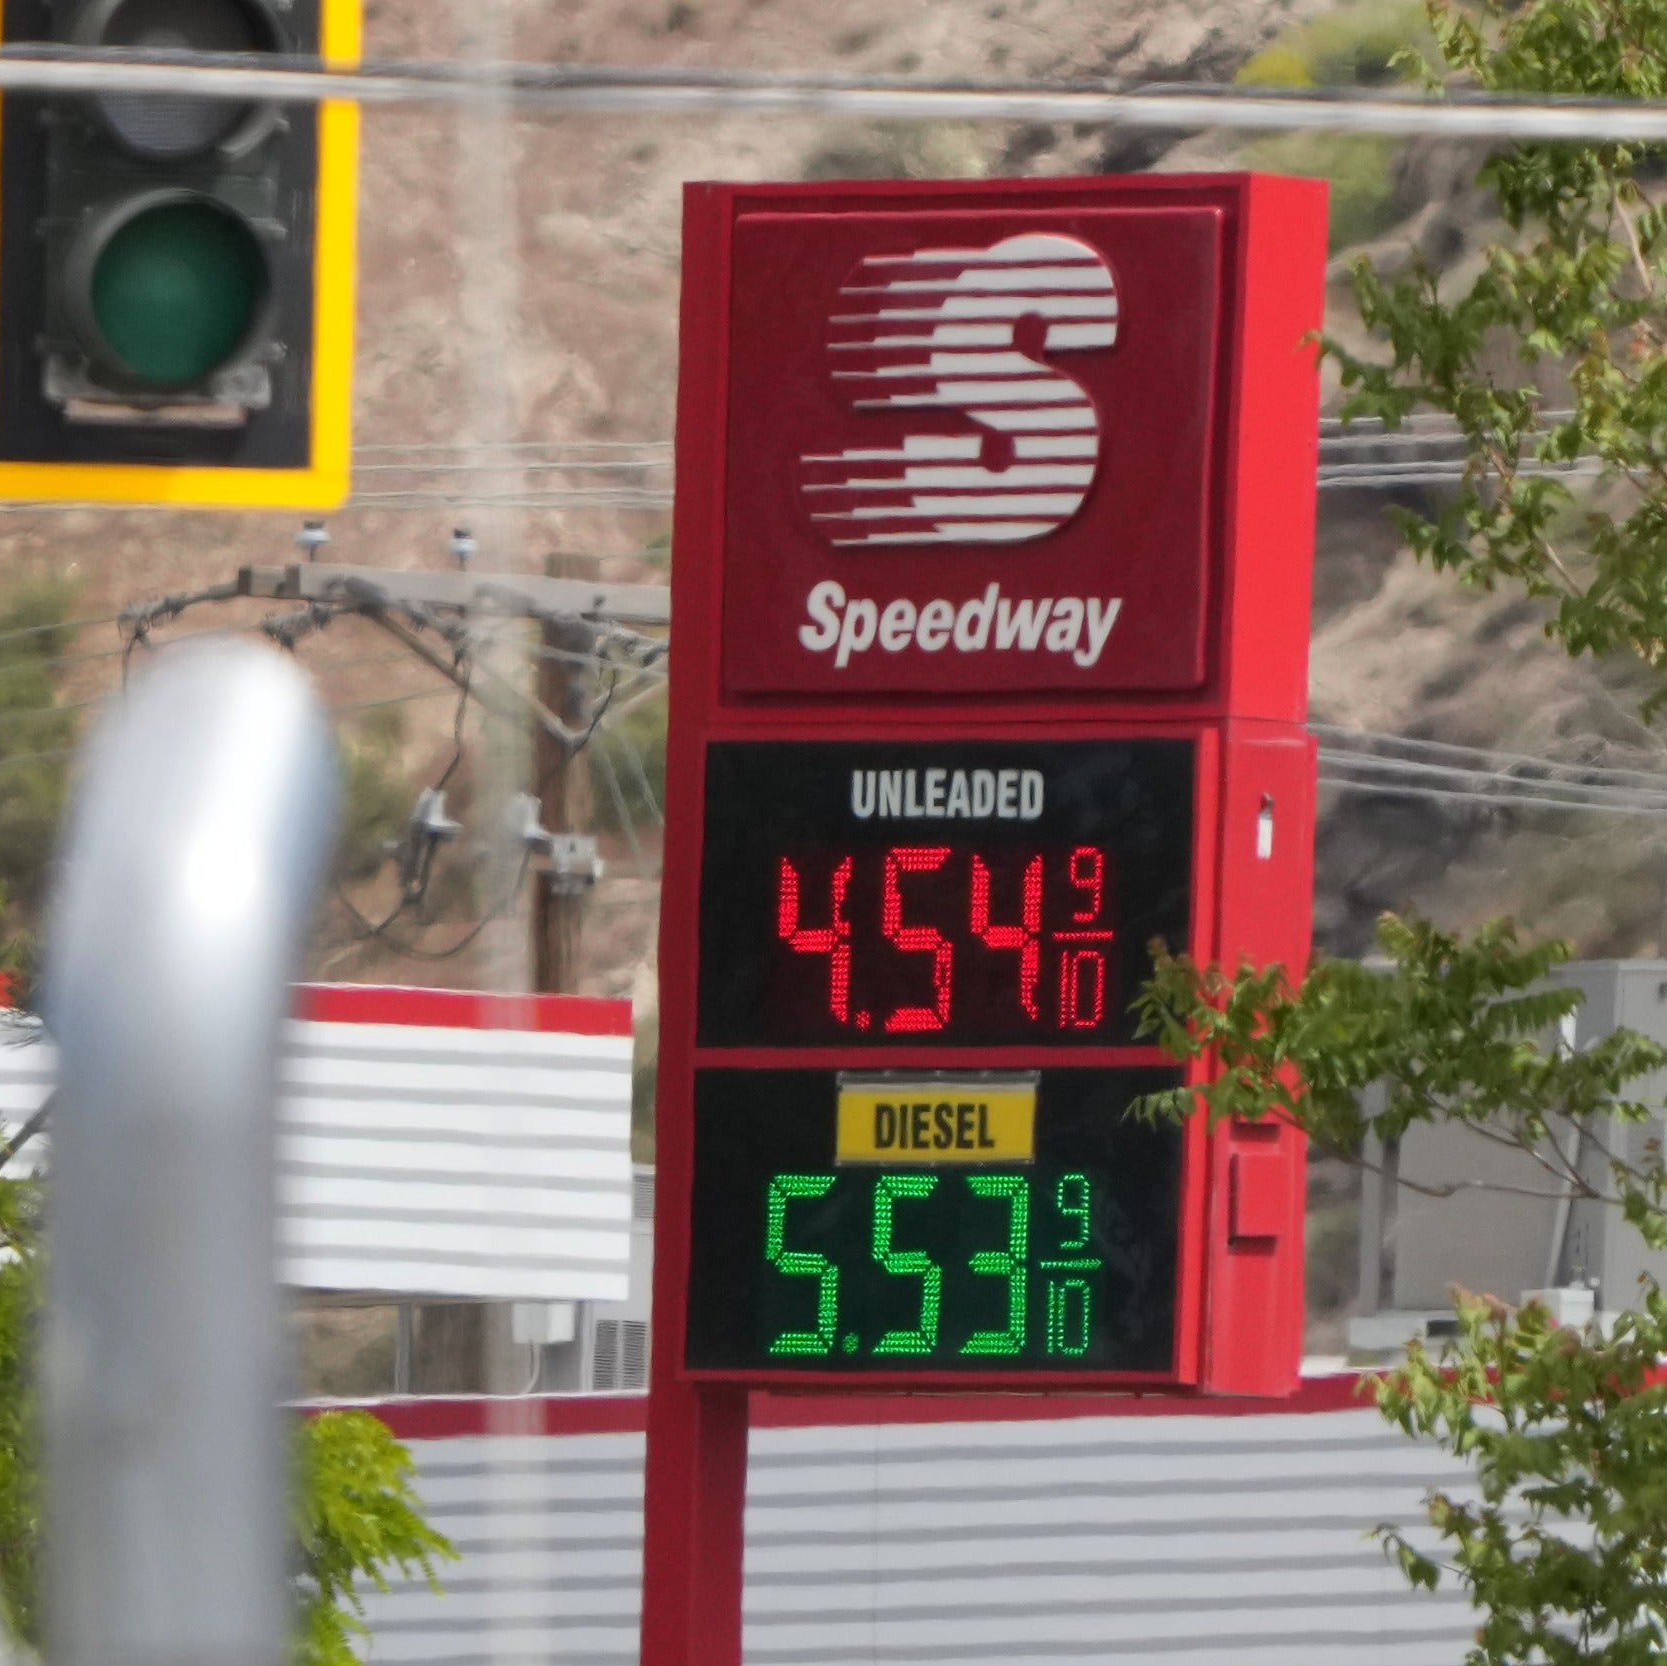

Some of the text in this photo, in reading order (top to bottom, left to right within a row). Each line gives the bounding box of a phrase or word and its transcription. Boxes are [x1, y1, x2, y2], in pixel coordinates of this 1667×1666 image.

[798, 580, 1122, 669] Speedway
[851, 769, 1044, 821] UNLEADED
[875, 1103, 996, 1150] DIESEL
